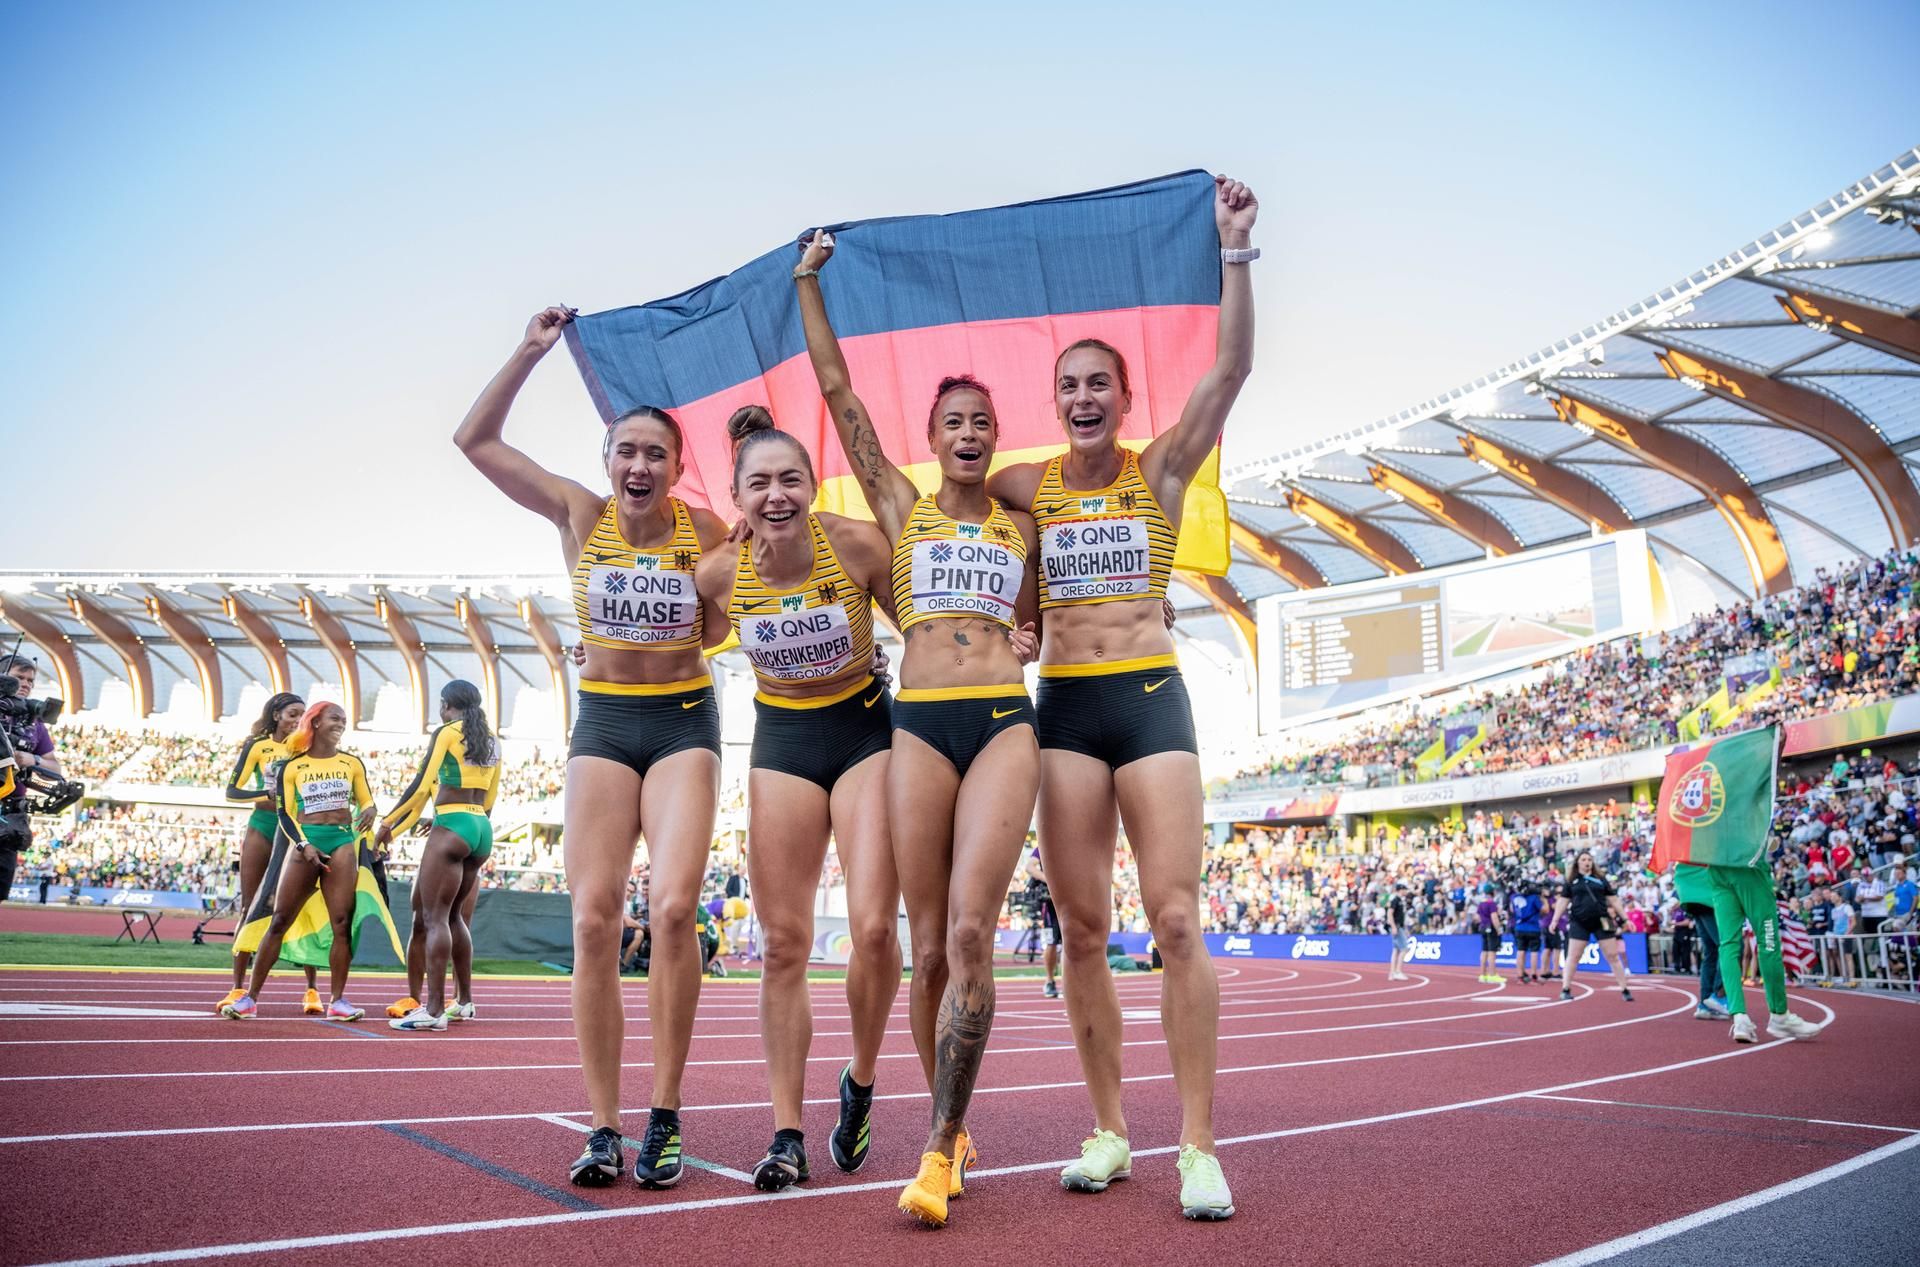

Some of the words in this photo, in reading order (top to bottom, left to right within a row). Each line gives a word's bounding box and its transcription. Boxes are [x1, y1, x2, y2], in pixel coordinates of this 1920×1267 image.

[1081, 525, 1132, 545] QNB
[958, 546, 1009, 566] QNB
[1046, 549, 1144, 578] BURGHARDT
[632, 575, 681, 595] QNB
[931, 567, 1005, 595] PINTO
[1061, 581, 1133, 597] OREGON22
[602, 598, 682, 623] HAASE
[928, 597, 1000, 616] OREGON22
[606, 626, 676, 642] OREGON22
[781, 613, 831, 638] QNB
[749, 635, 850, 668] LÜCKENKEMPER
[303, 771, 348, 783] JAMAICA
[320, 780, 344, 789] QNB
